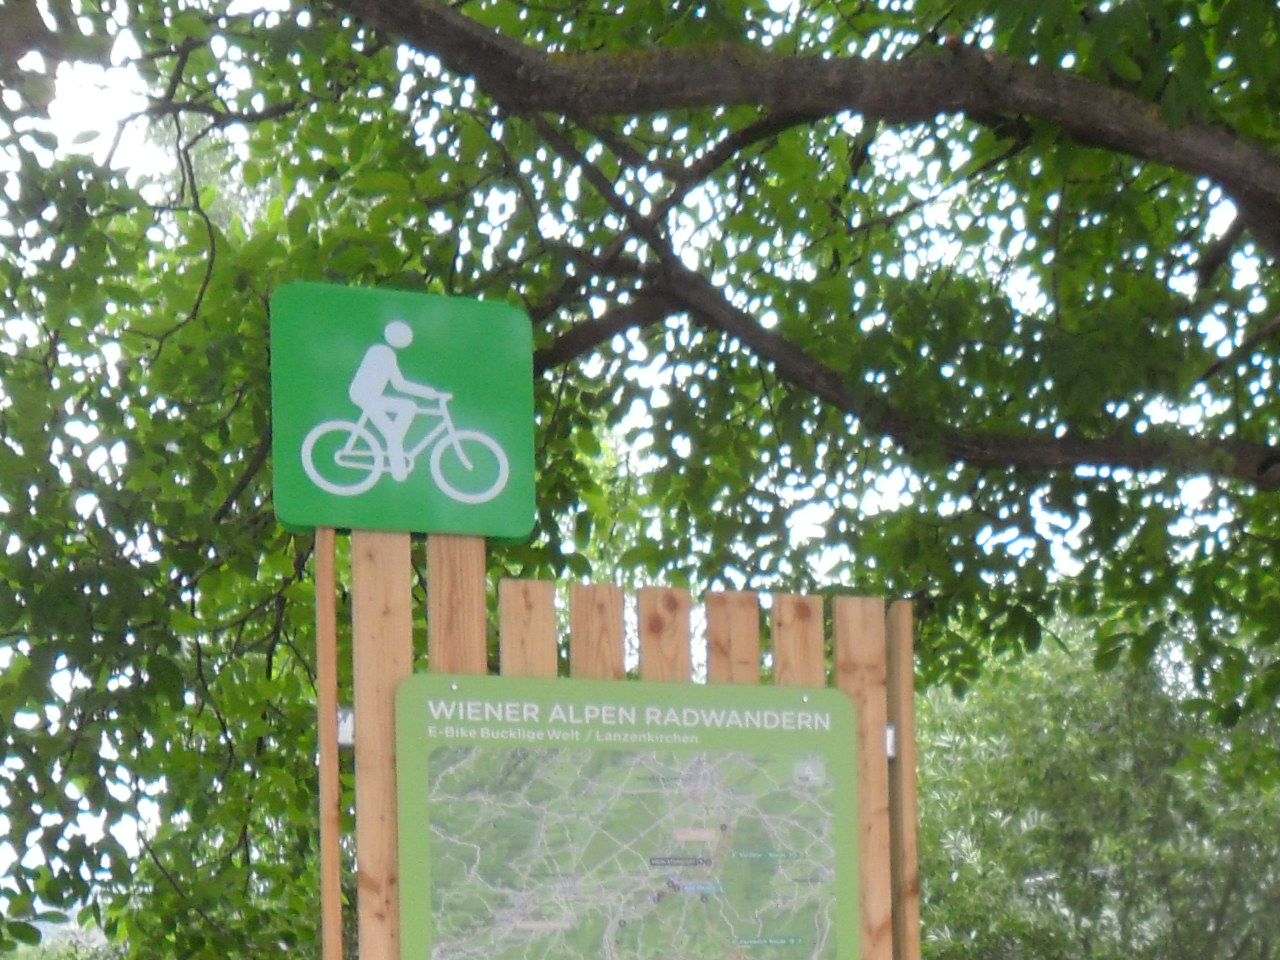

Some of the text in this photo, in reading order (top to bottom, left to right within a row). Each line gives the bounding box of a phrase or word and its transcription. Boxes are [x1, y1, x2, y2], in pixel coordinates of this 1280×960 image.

[428, 700, 831, 731] WIENER ALPEN RADWANDERN
[428, 725, 476, 738] E-Bike
[480, 727, 545, 742] Bucklige
[547, 730, 580, 741] Welt
[596, 730, 698, 743] Lanzenkirchen
